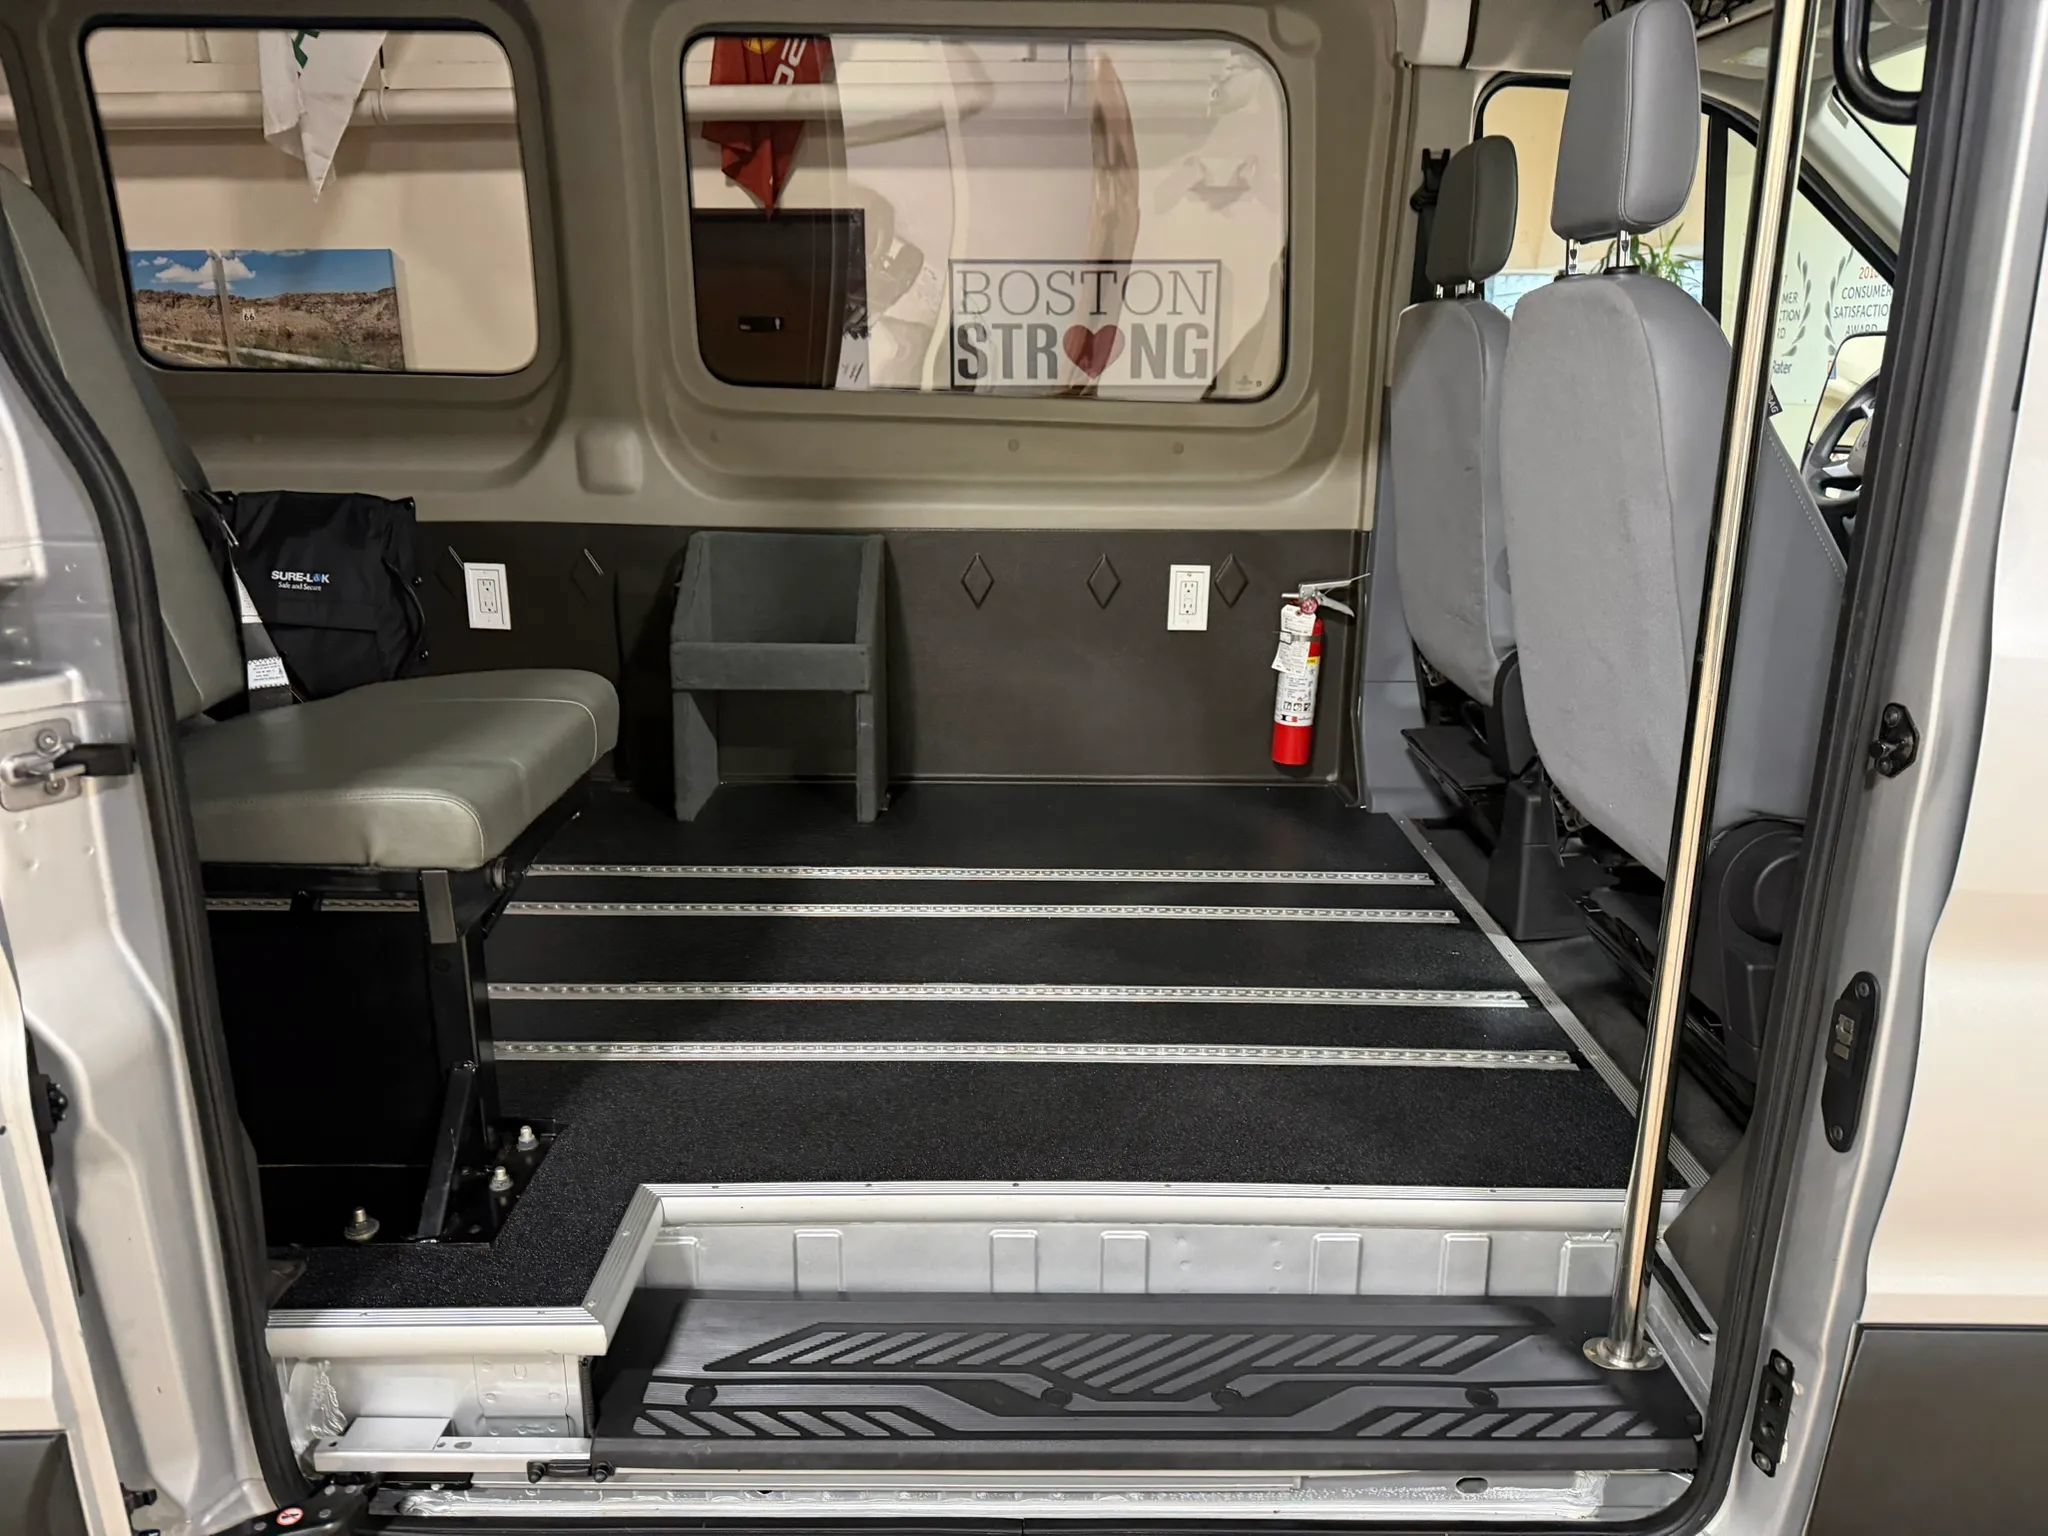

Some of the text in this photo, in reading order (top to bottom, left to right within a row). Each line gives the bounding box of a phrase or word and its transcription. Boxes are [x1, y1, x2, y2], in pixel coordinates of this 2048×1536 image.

[957, 270, 1213, 316] BOSTON
[1842, 284, 1892, 300] CONSUMER
[244, 312, 255, 321] 66
[1833, 303, 1889, 319] SATISFACTIO
[278, 581, 291, 589] Safe
[303, 583, 322, 591] Secure
